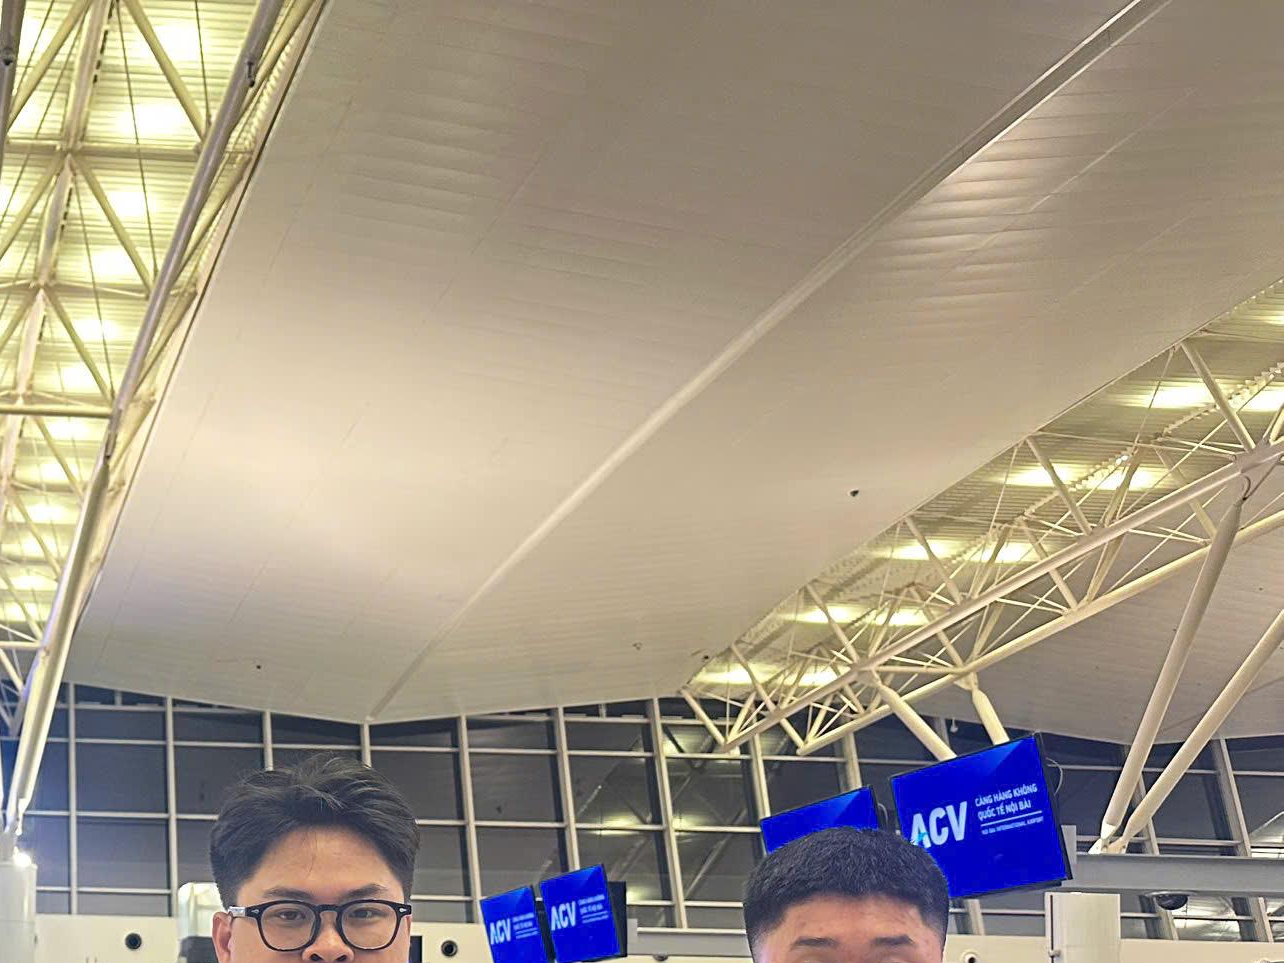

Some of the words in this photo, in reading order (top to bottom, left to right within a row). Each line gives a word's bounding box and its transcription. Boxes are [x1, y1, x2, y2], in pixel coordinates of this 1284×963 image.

[910, 801, 967, 848] ACV
[551, 901, 576, 931] ACV
[490, 918, 511, 945] ACV
